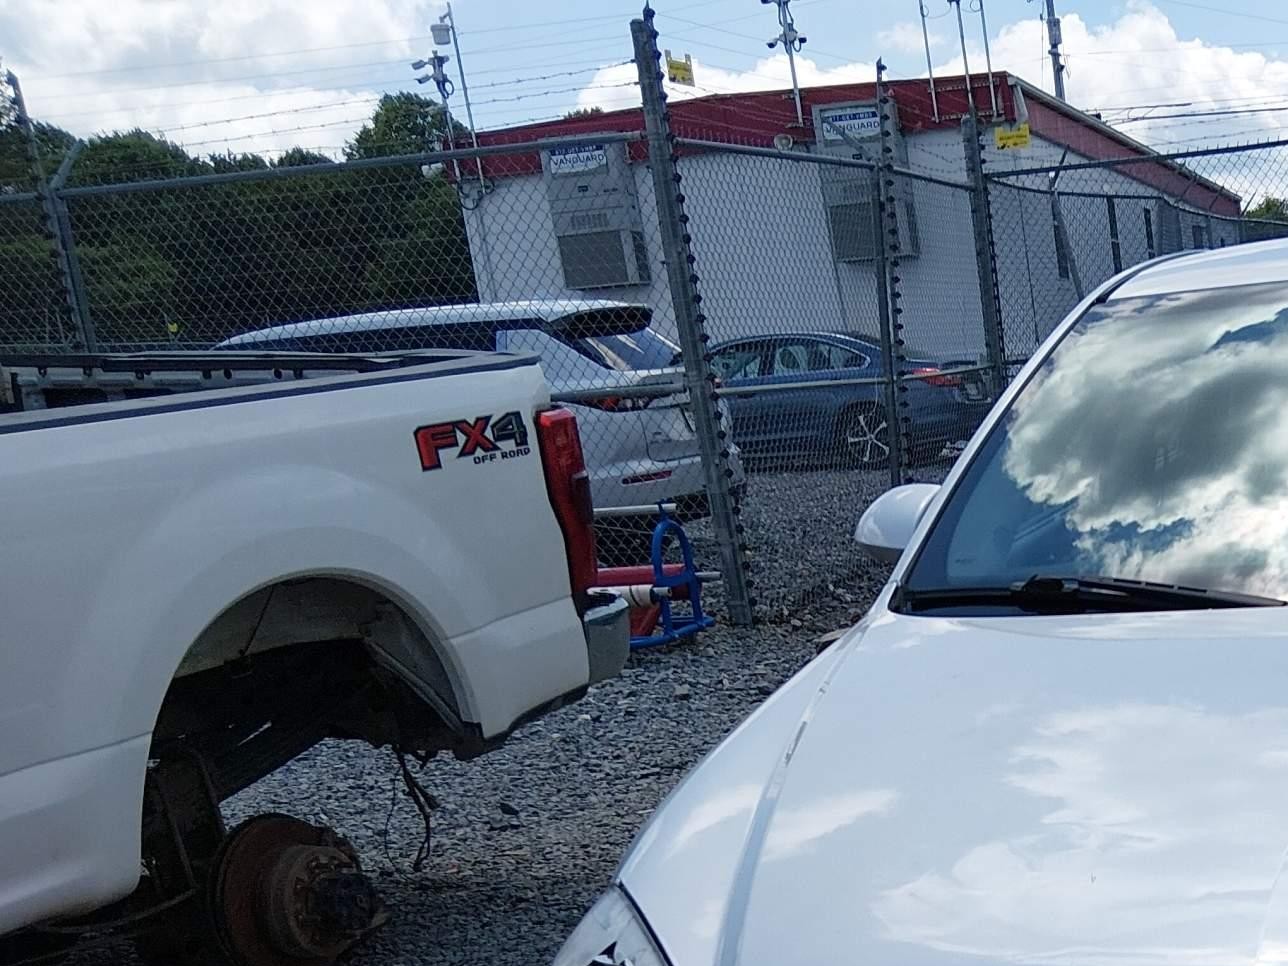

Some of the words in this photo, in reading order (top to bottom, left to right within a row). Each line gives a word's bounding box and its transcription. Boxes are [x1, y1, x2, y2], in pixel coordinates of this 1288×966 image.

[552, 153, 605, 167] VANGUARD
[413, 410, 529, 473] FX4
[473, 452, 498, 465] OFF
[501, 447, 532, 460] ROAD
